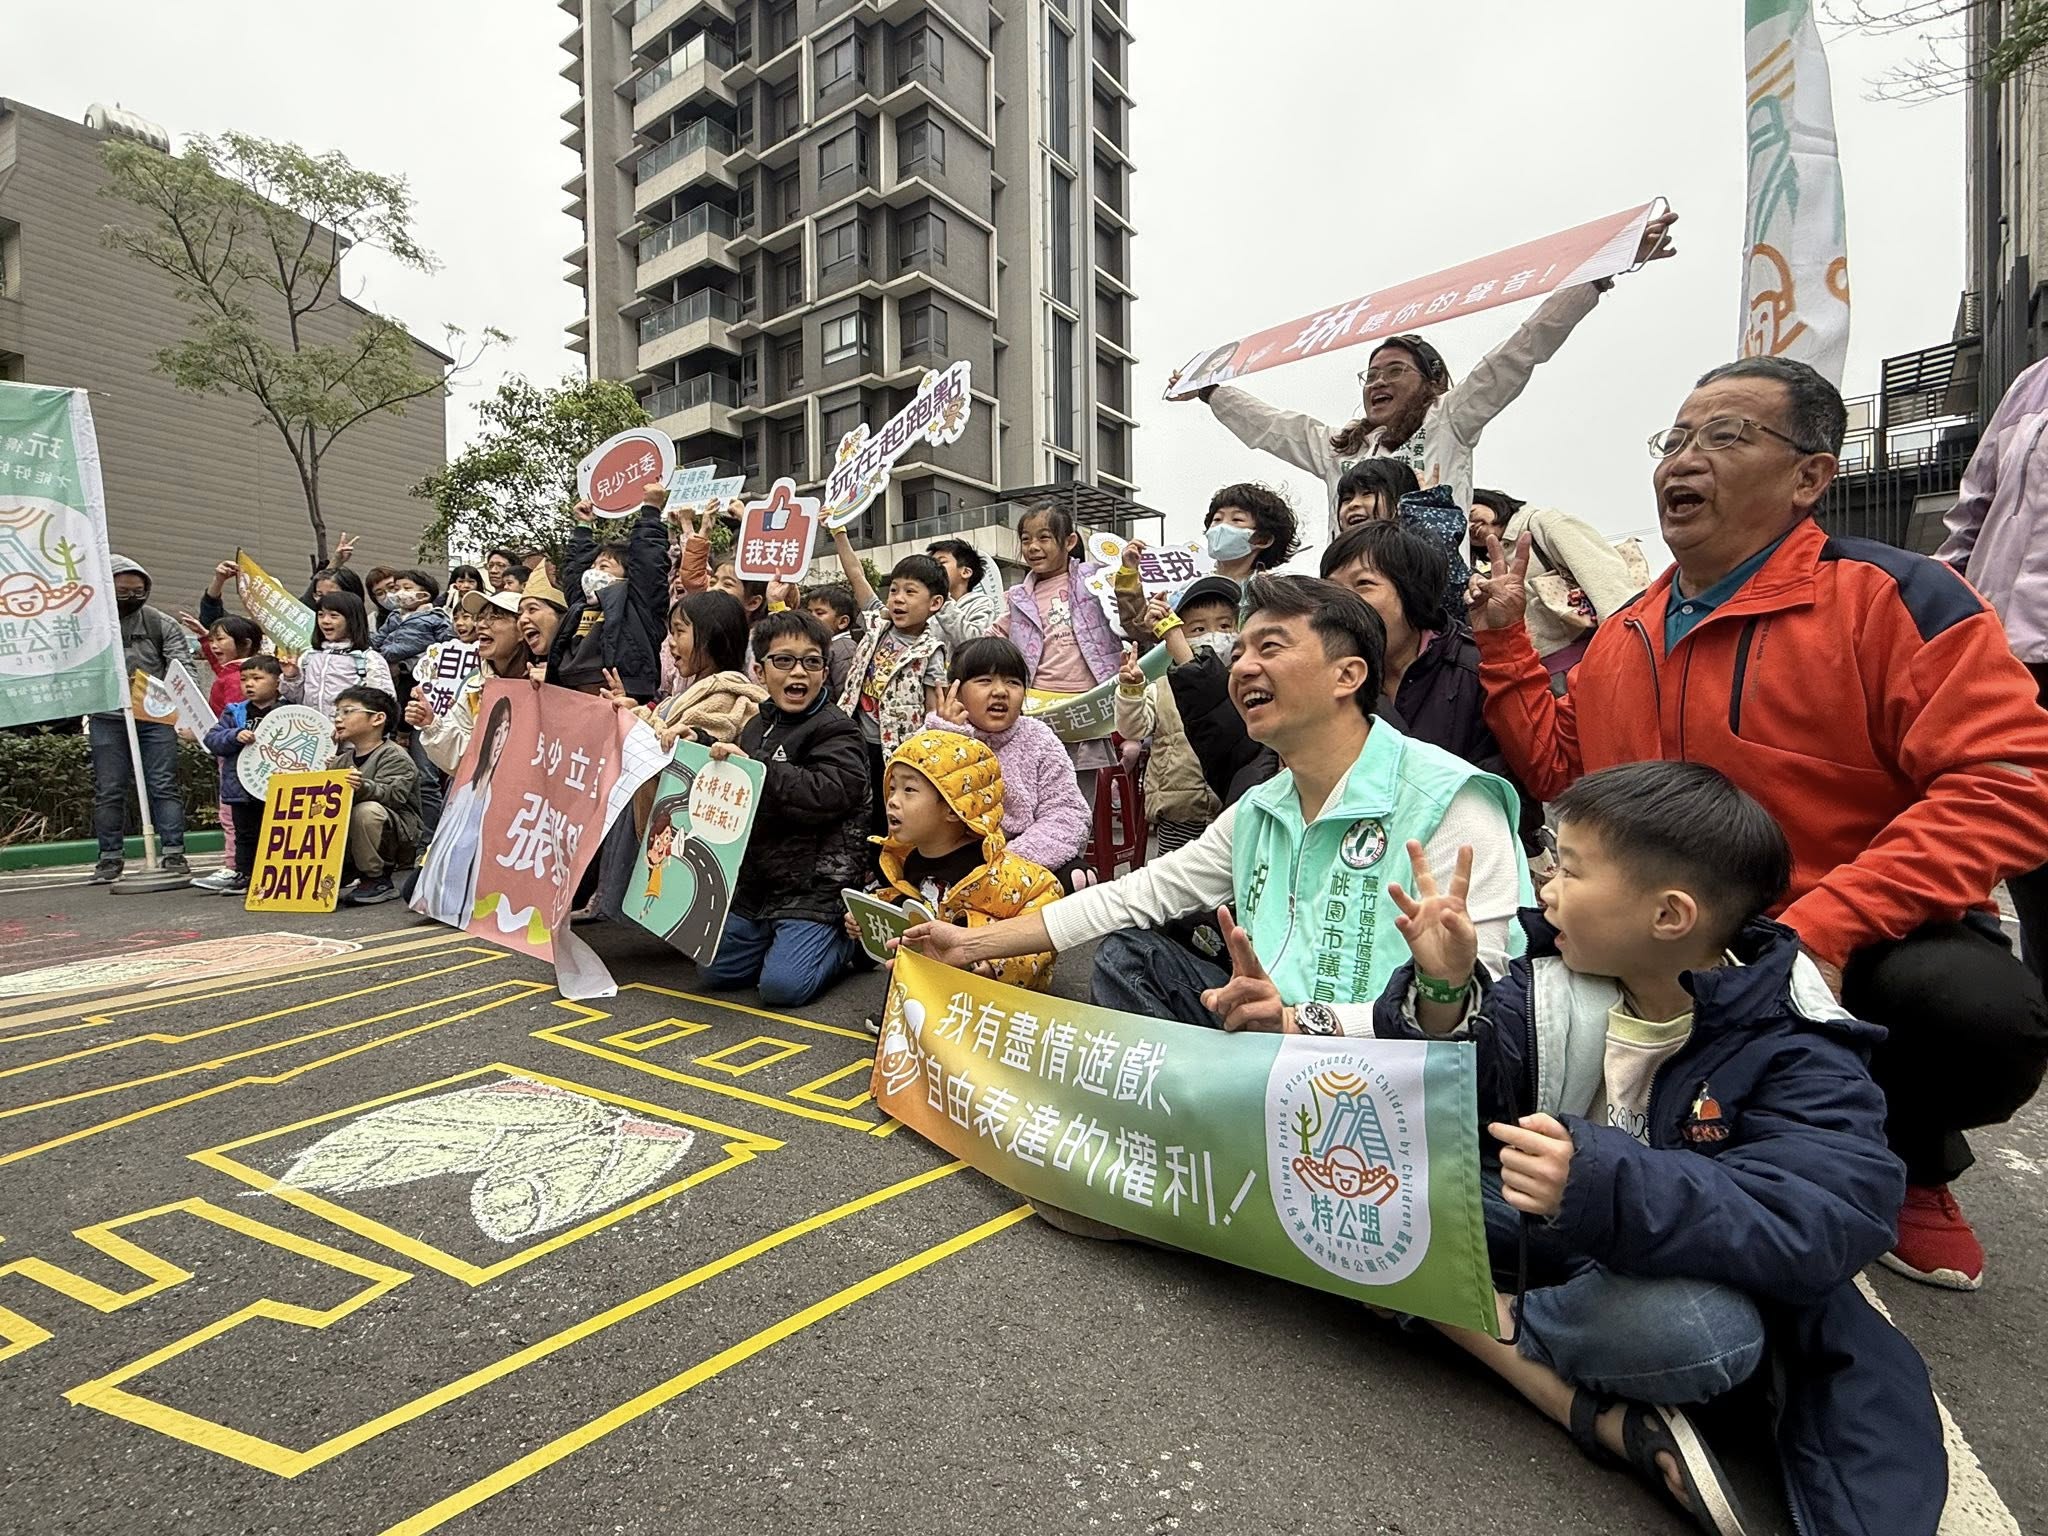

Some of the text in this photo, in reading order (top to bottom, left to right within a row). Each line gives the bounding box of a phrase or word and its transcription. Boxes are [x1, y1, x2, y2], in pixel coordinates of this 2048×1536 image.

[1281, 263, 1557, 354] 琳聽你的聲音!
[829, 368, 962, 503] 玩在起跑點
[596, 452, 656, 501] 兒少立委
[745, 538, 799, 567] 我支持
[438, 645, 481, 680] 自由
[272, 779, 344, 821] LET'S
[265, 824, 339, 861] PLAY
[260, 864, 324, 901] DAY!
[1313, 871, 1352, 1004] 桃園市議員
[932, 990, 1173, 1117] 我有盡情遊戲、
[1285, 1053, 1354, 1093] Playgrounds
[1357, 1058, 1375, 1075] for
[1374, 1074, 1408, 1134] Children
[925, 1053, 1257, 1226] 自由表達的權利!
[1279, 1112, 1289, 1150] Parks
[1400, 1141, 1412, 1157] by
[1282, 1155, 1292, 1201] Taiwan
[1401, 1164, 1413, 1228] Children
[1310, 1193, 1385, 1247] 特公盟
